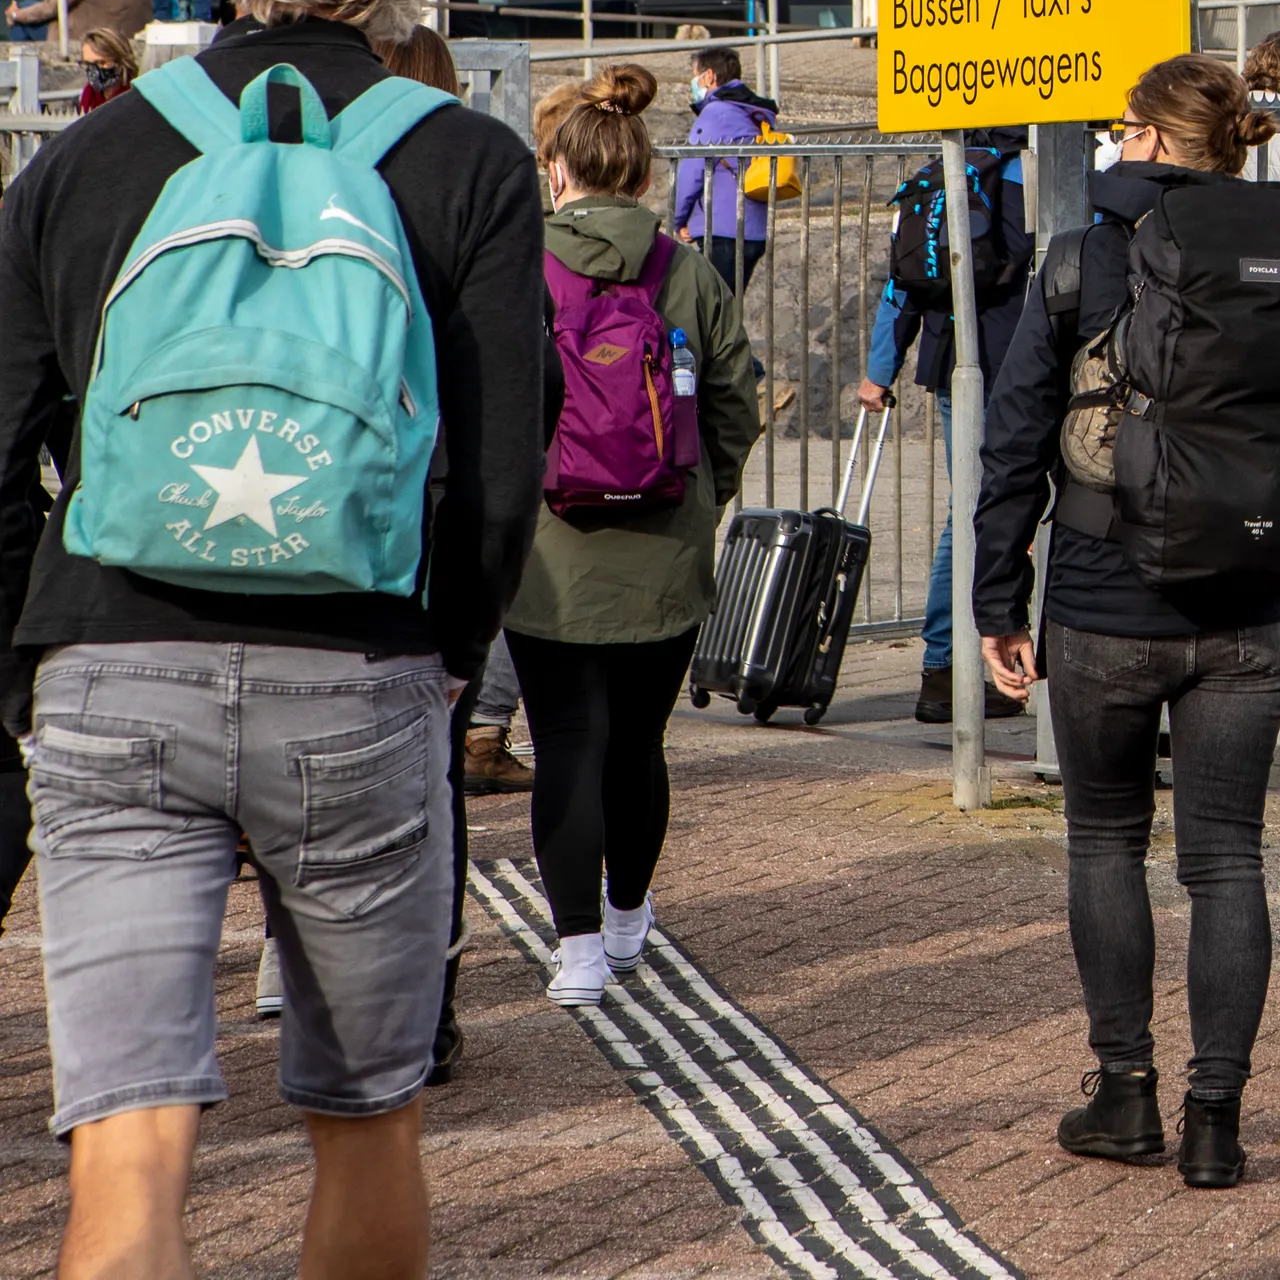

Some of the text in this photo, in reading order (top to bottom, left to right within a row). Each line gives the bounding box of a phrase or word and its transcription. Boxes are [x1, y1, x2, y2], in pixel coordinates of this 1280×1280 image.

[893, 49, 1102, 108] Bagagewagens
[1249, 266, 1278, 274] FORCLAZ
[170, 408, 334, 471] CONVERSE
[158, 482, 214, 509] Chuck
[276, 495, 330, 524] Taylor
[604, 493, 641, 501] Quechua
[165, 519, 218, 563] ALL
[230, 531, 311, 568] STAR
